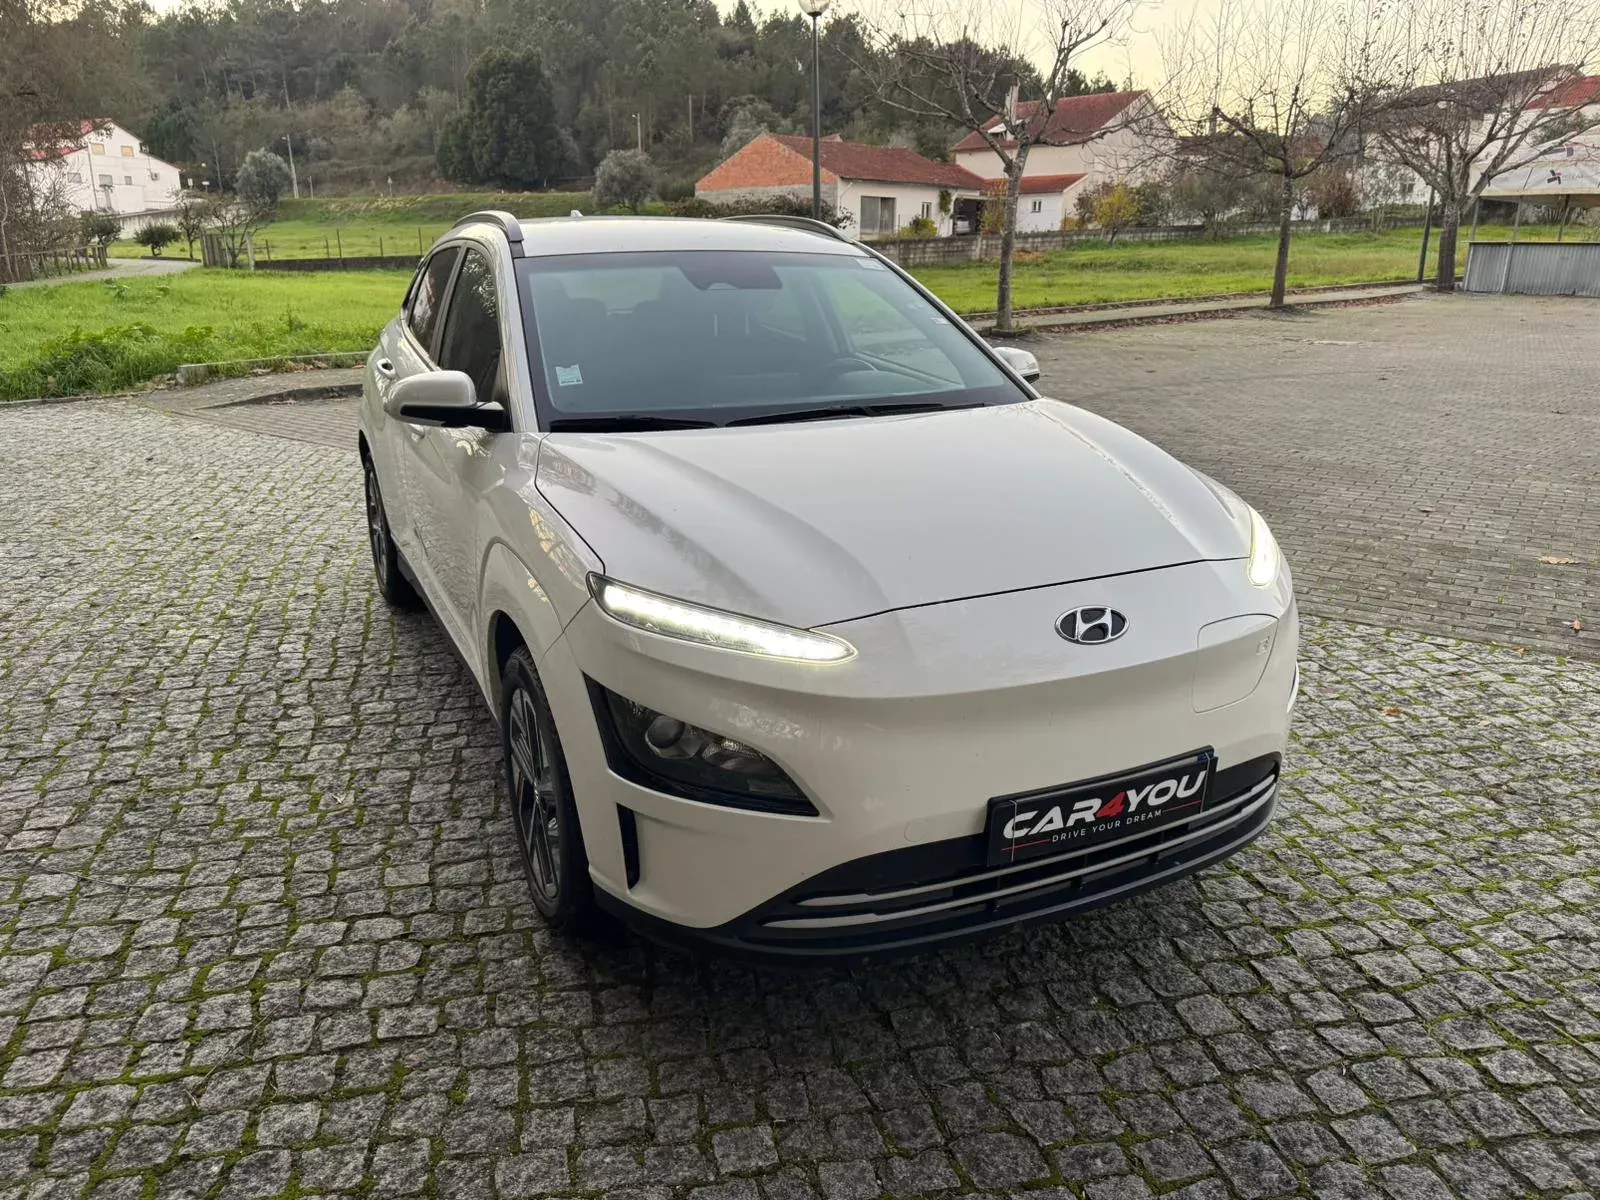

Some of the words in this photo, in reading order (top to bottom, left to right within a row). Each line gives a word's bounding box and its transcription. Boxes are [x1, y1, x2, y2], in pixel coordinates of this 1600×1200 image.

[1003, 770, 1207, 839] CAR4YOU
[1052, 828, 1086, 843] DRIVE
[1092, 820, 1121, 833] YOUR
[1126, 809, 1163, 825] DREAM
